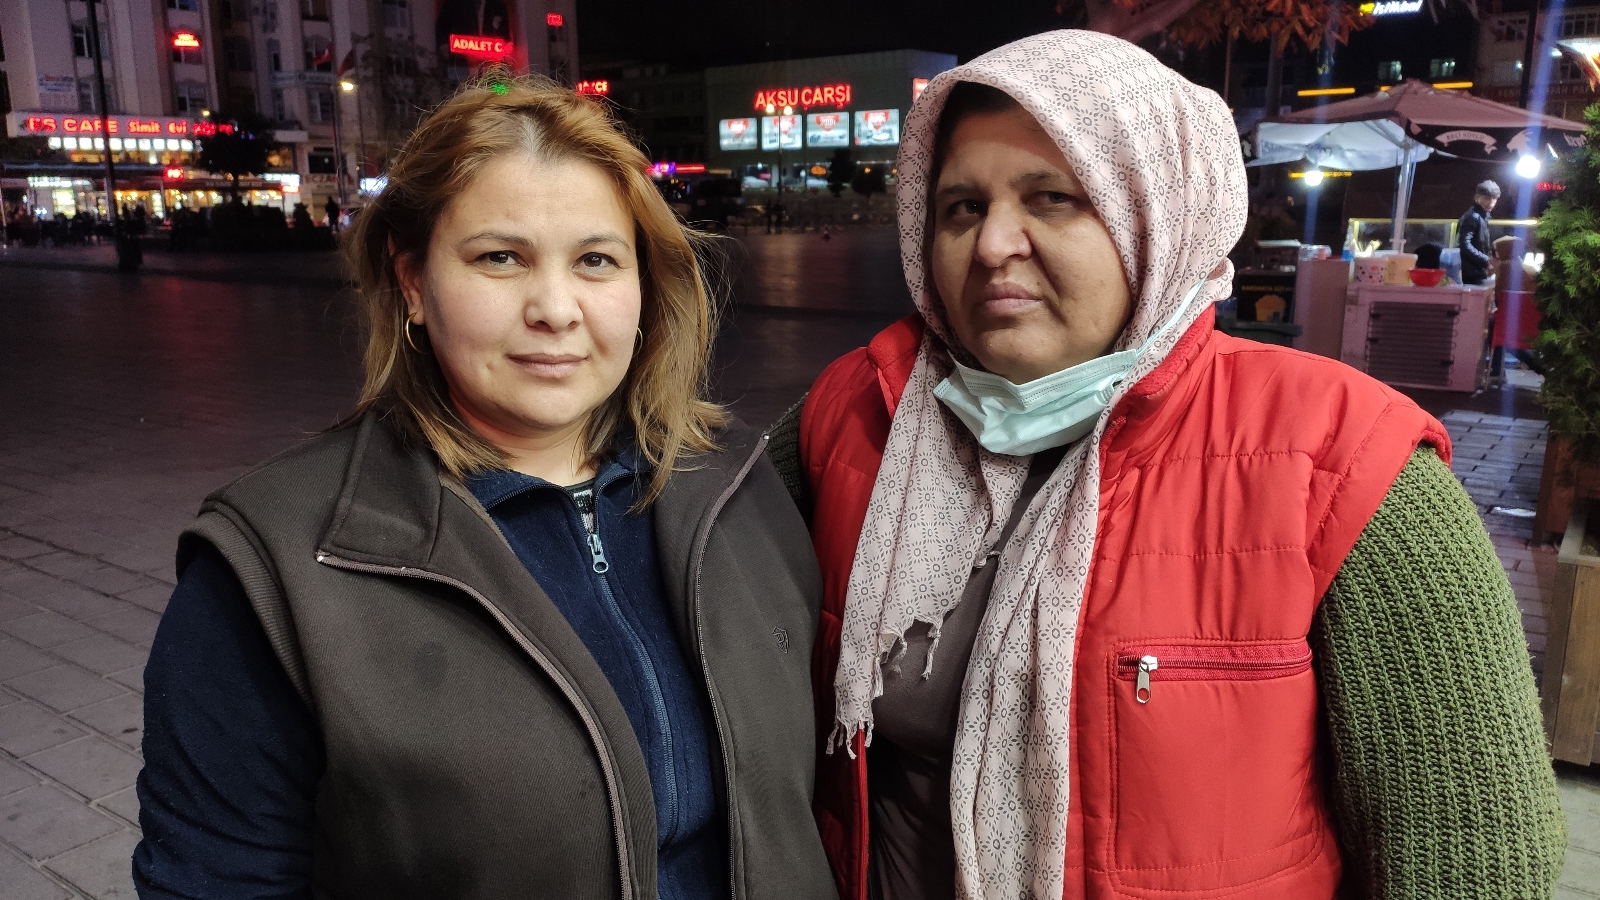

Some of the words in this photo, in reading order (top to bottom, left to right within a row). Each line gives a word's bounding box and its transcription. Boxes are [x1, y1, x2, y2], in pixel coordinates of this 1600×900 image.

[453, 38, 493, 51] ADALET
[754, 89, 799, 109] AKSU
[128, 120, 161, 134] Simit
